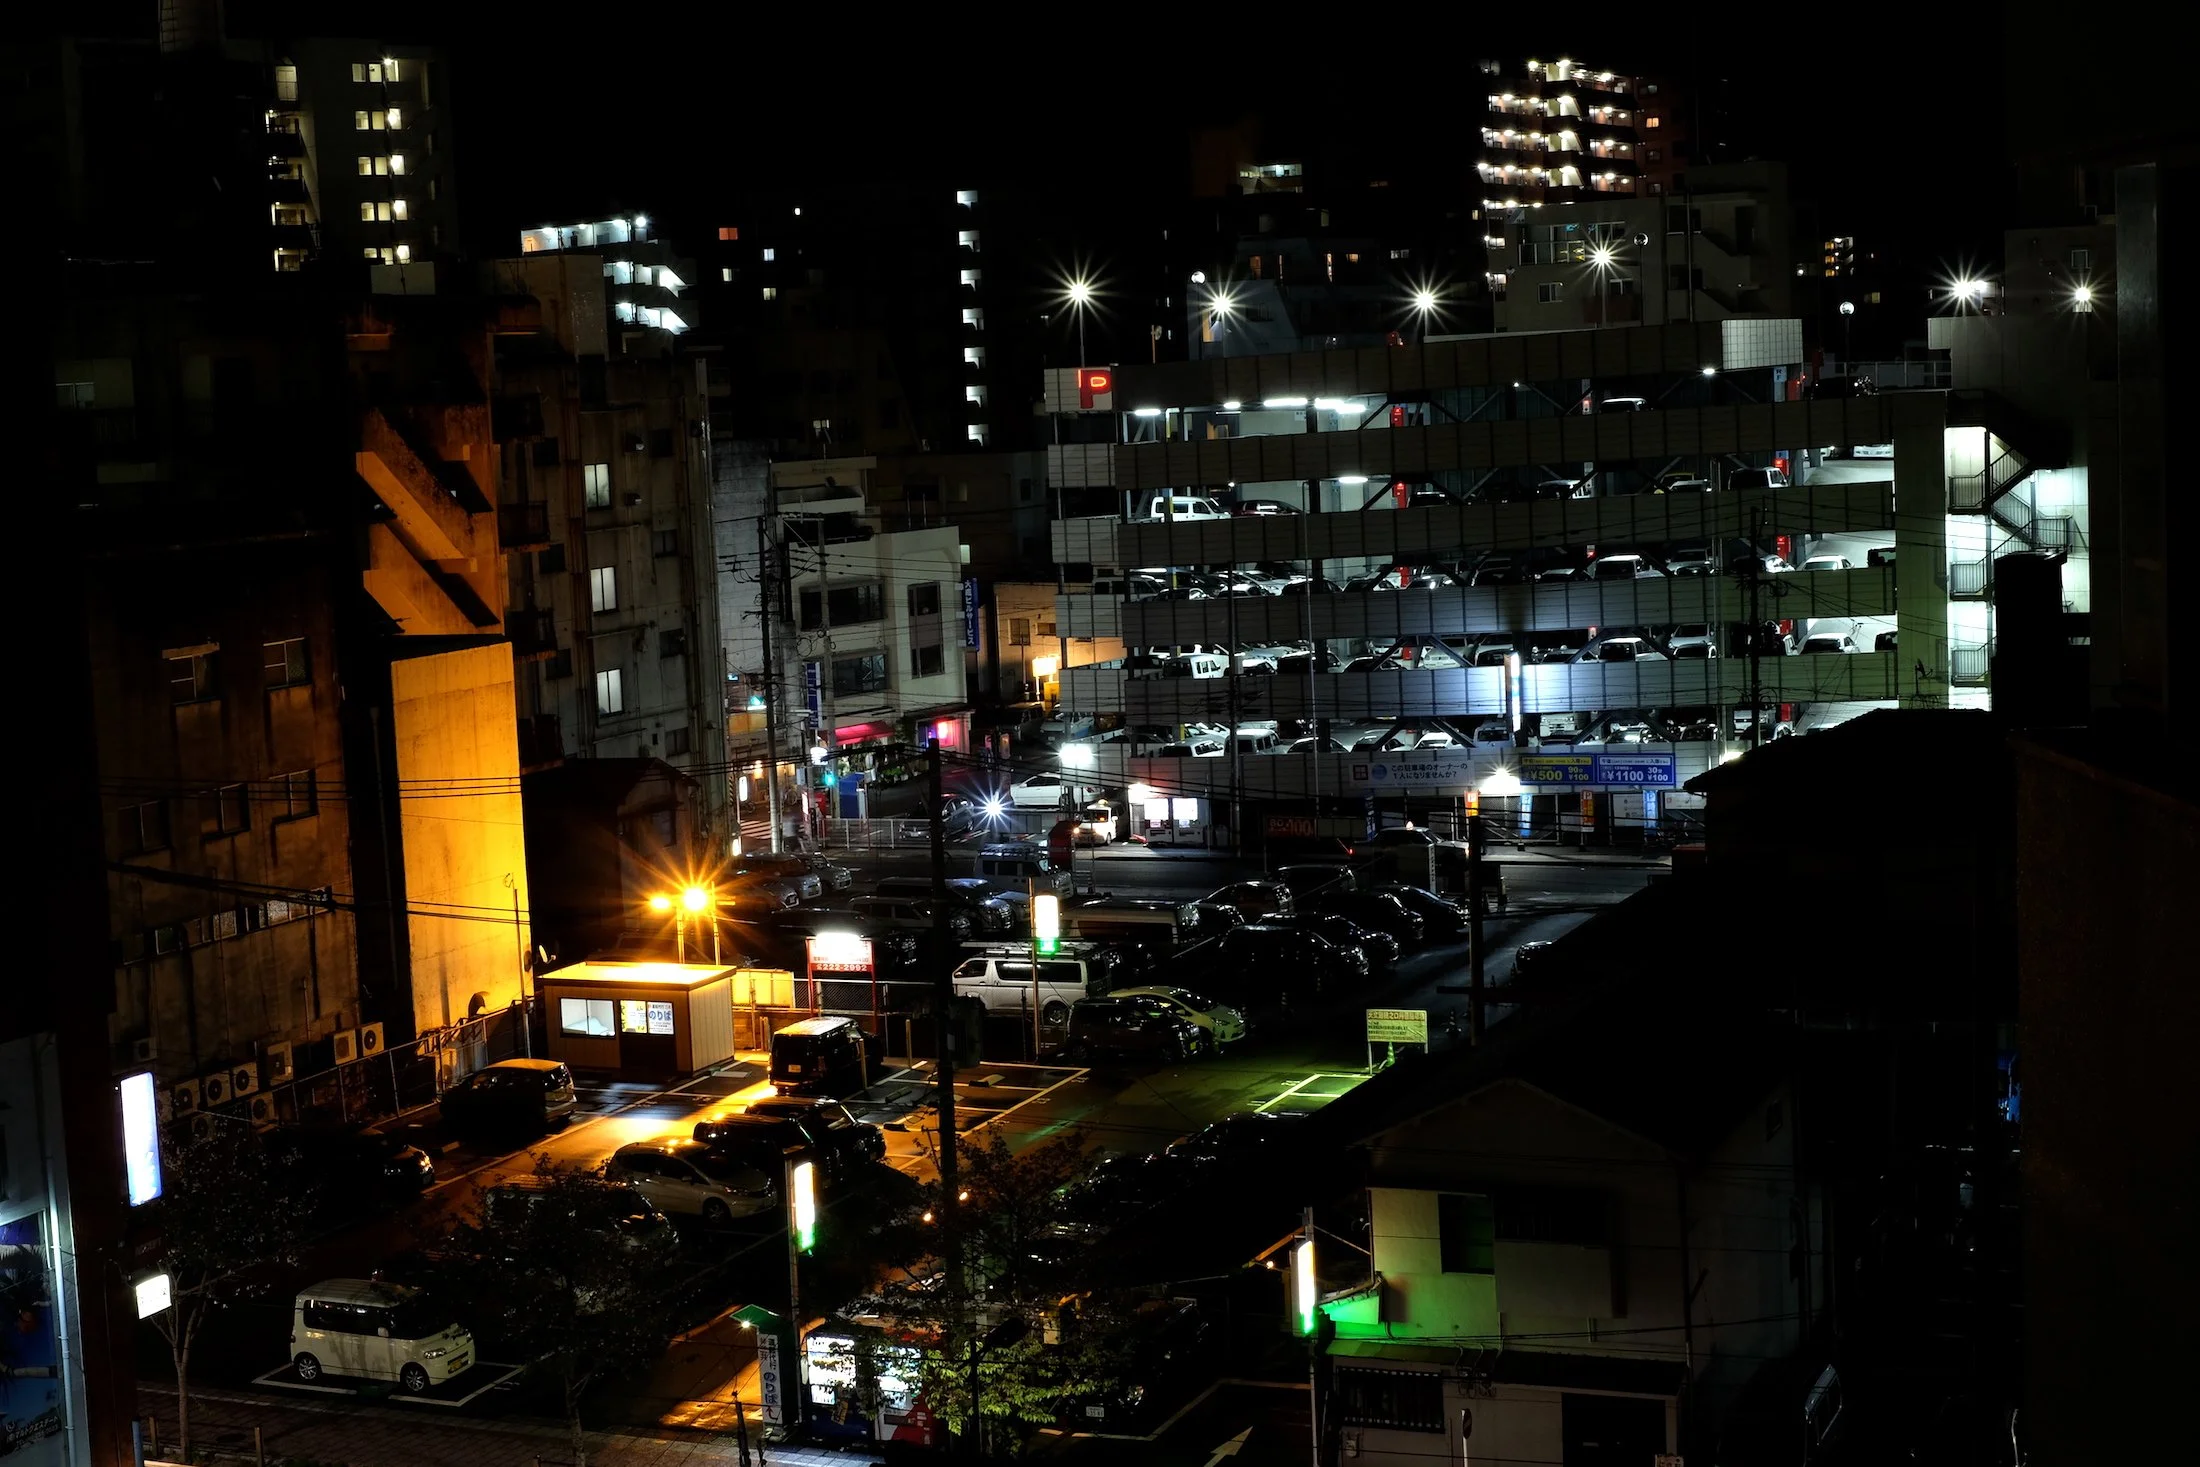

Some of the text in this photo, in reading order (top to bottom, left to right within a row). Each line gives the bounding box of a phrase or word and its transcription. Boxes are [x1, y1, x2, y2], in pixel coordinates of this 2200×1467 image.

[1078, 369, 1112, 409] P
[1530, 770, 1563, 781] ¥500
[1606, 770, 1645, 781] ¥1100
[1647, 773, 1669, 782] ¥100
[648, 1010, 672, 1022] のりば
[763, 1371, 779, 1405] のりば
